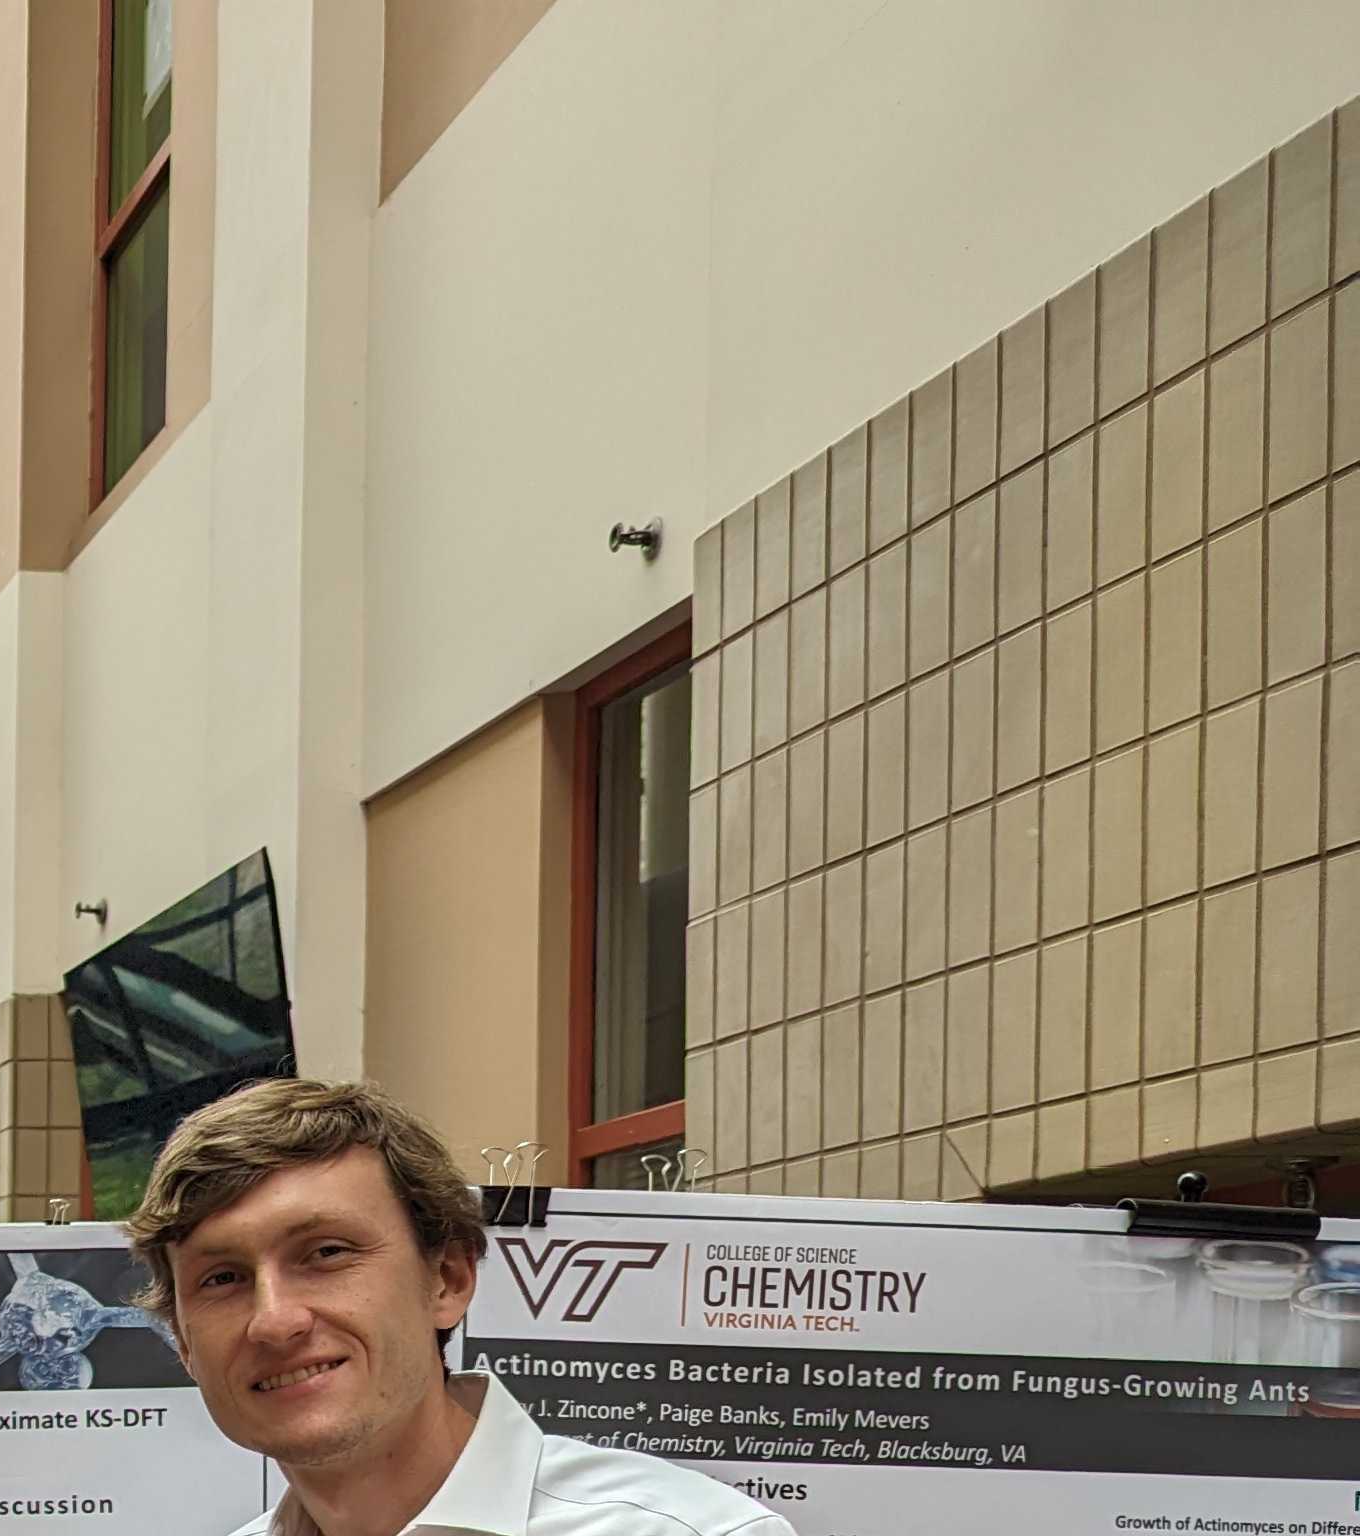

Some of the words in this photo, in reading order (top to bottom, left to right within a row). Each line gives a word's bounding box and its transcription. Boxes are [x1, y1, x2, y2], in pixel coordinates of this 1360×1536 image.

[707, 1244, 771, 1266] COLLEGE
[775, 1247, 793, 1262] OF
[796, 1247, 856, 1264] SCIENCE
[495, 1237, 668, 1322] VT
[704, 1266, 926, 1318] CHEMISTRY
[704, 1312, 797, 1330] VIRGINIA
[474, 1352, 657, 1384] Actinomyces
[669, 1360, 789, 1384] Bacteria
[803, 1364, 920, 1388] Isolated
[933, 1367, 999, 1390] from
[1013, 1371, 1238, 1404] Fungus-Growing
[1249, 1380, 1309, 1408] Ants
[86, 1408, 167, 1427] KS-DFT
[538, 1401, 551, 1418] J.
[660, 1404, 713, 1426] Paige
[720, 1406, 785, 1428] Banks,
[793, 1408, 849, 1431] Emily
[855, 1410, 929, 1429] Mevers
[598, 1431, 622, 1449] of
[623, 1432, 726, 1457] Chemistry,
[734, 1435, 814, 1459] Virginia
[820, 1439, 870, 1461] Tech,
[878, 1440, 992, 1465] Blacksburg,
[1001, 1445, 1026, 1463] VA
[1116, 1516, 1171, 1529] Growth
[1176, 1517, 1190, 1530] of
[1194, 1518, 1284, 1535] Actinomyces
[1289, 1524, 1306, 1534] on
